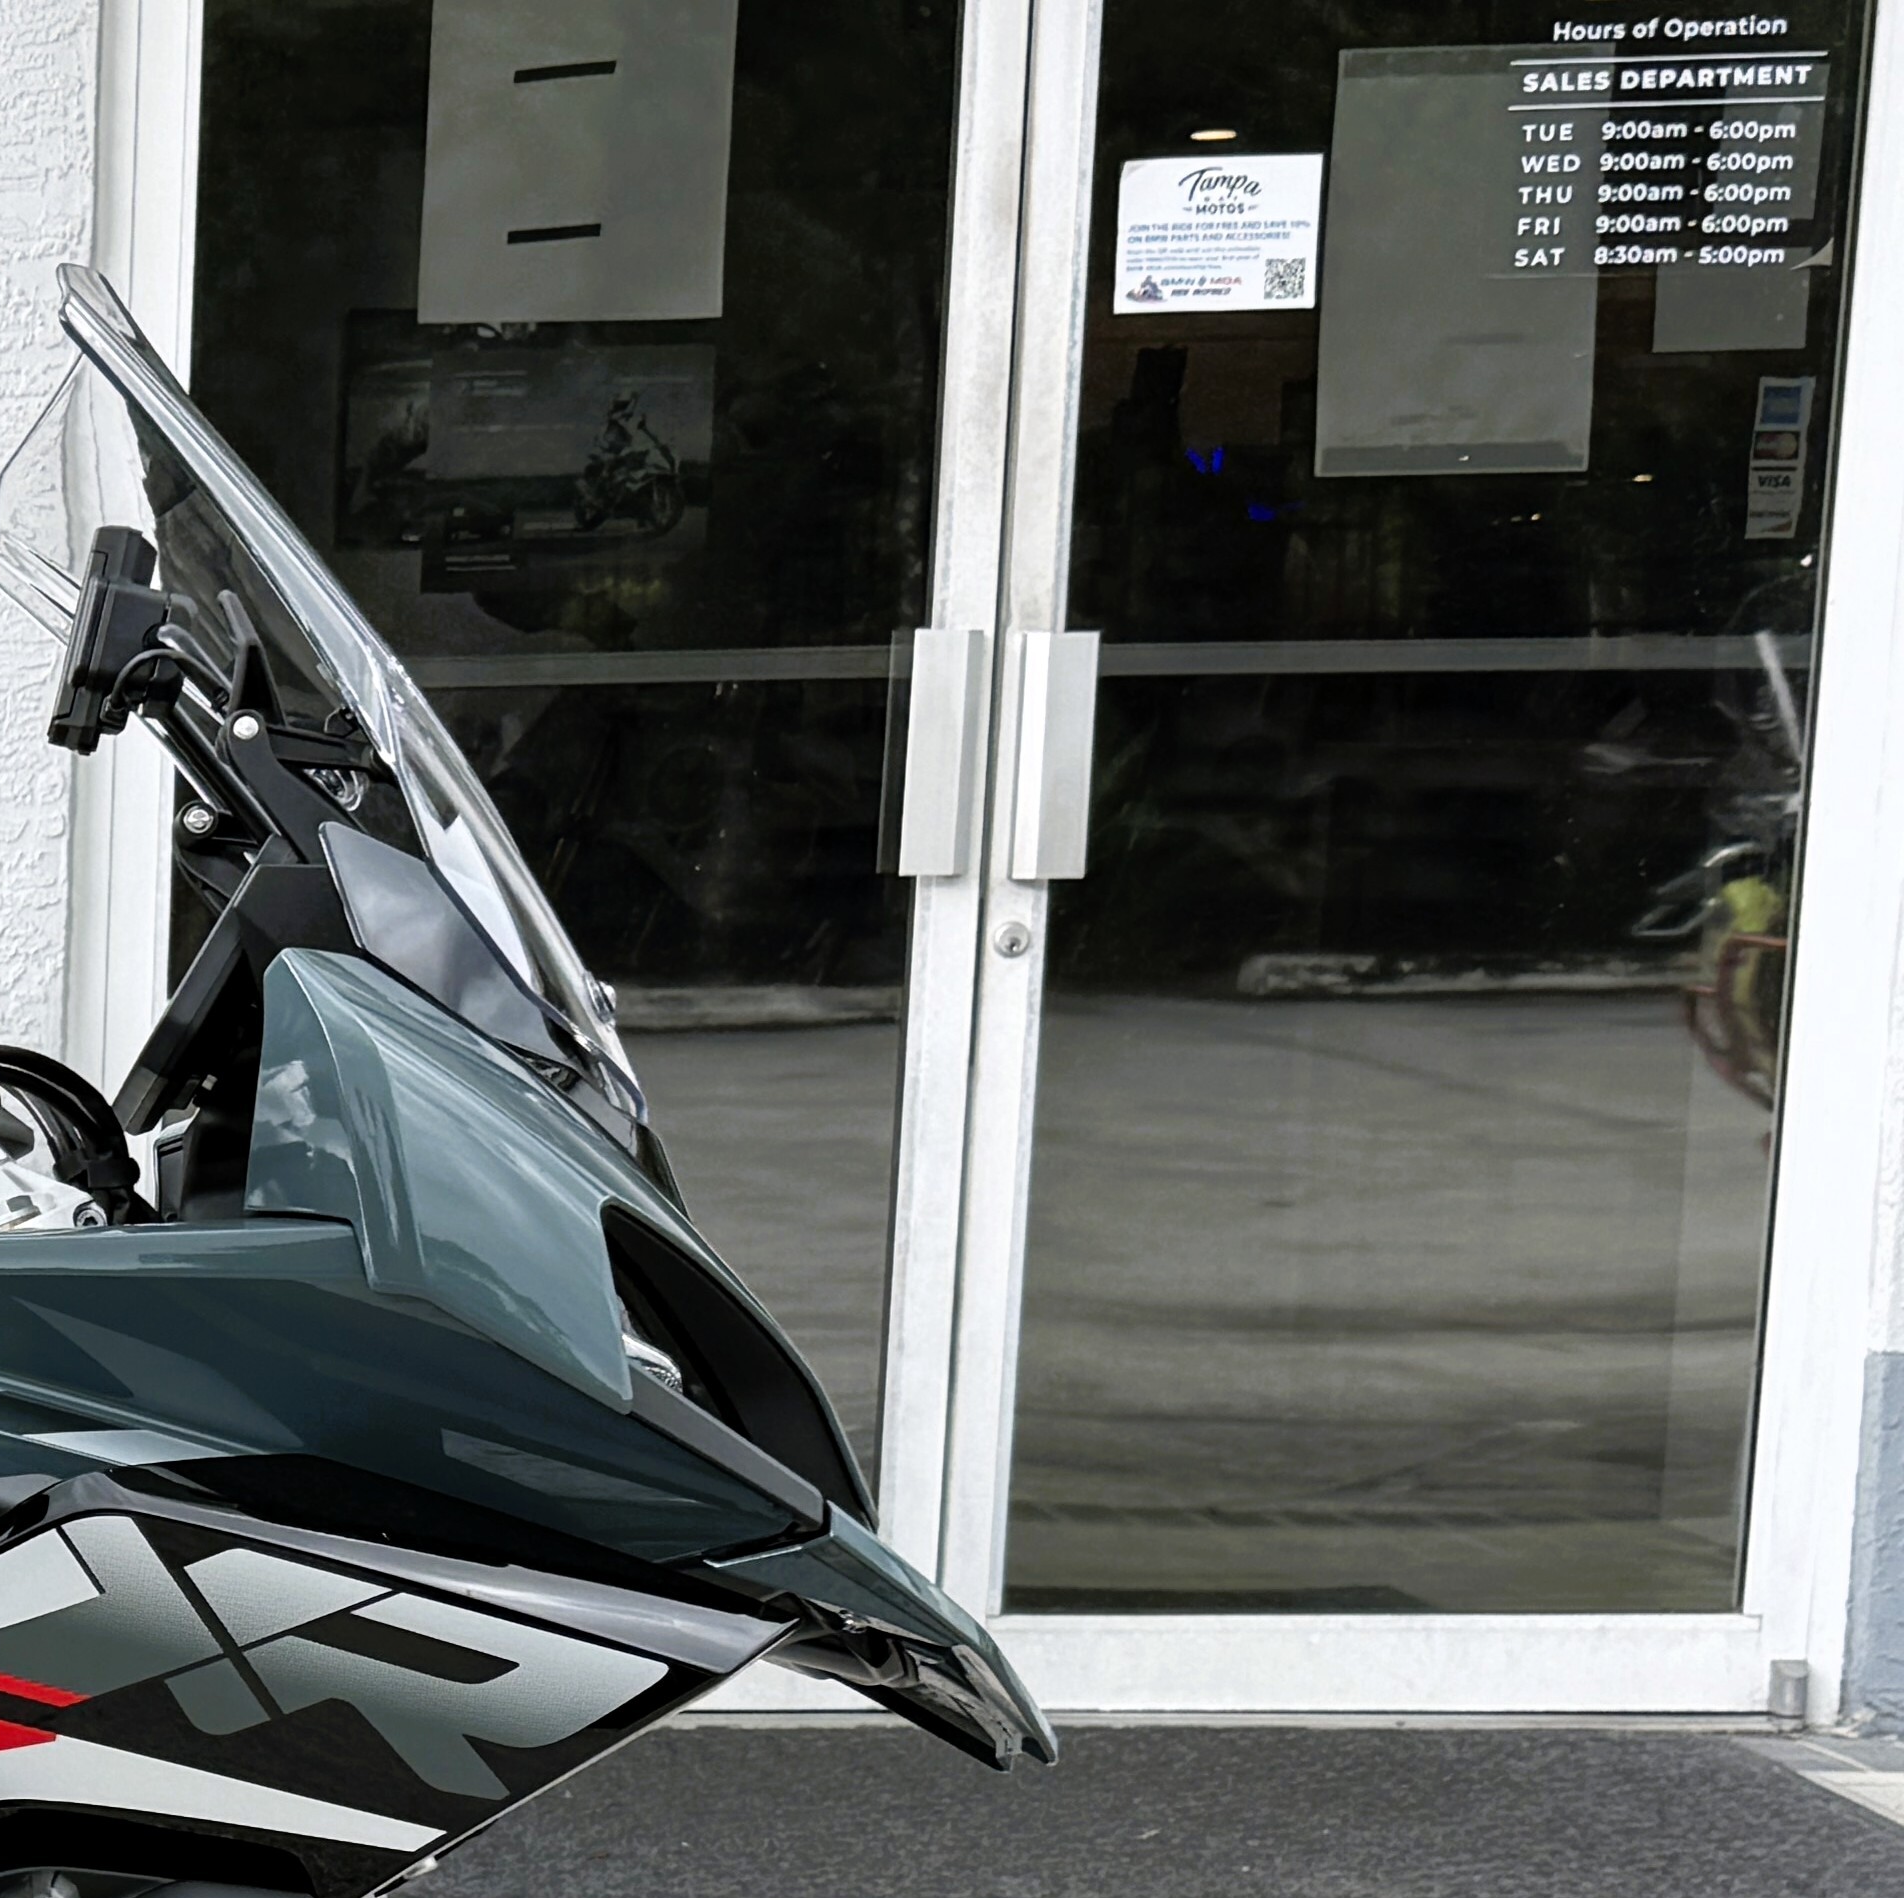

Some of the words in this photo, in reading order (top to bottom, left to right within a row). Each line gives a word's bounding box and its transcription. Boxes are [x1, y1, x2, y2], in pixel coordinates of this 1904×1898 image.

[1553, 20, 1626, 41] Hours
[1632, 17, 1660, 38] of
[1664, 14, 1788, 41] Operation
[1523, 70, 1611, 93] SALES
[1620, 65, 1813, 90] DEPARTMENT
[1522, 123, 1574, 142] TUE
[1601, 121, 1688, 140] 9:00am
[1709, 121, 1796, 143] 6:00pm
[1521, 154, 1581, 174] WED
[1599, 153, 1685, 172] 9:00am
[1706, 153, 1794, 174] 6:00pm
[1178, 166, 1262, 202] Tampa
[1518, 185, 1573, 204] THU
[1597, 183, 1684, 203] 9:00am
[1703, 184, 1791, 205] 6:00pm
[1195, 203, 1245, 215] MOTOS
[1517, 216, 1561, 236] FRI
[1595, 214, 1681, 234] 9:00am
[1701, 215, 1789, 236] 6:00pm
[1514, 247, 1566, 267] SAT
[1593, 245, 1678, 265] 8:30am
[1698, 246, 1785, 267] 5:00pm
[1758, 475, 1791, 487] VISA
